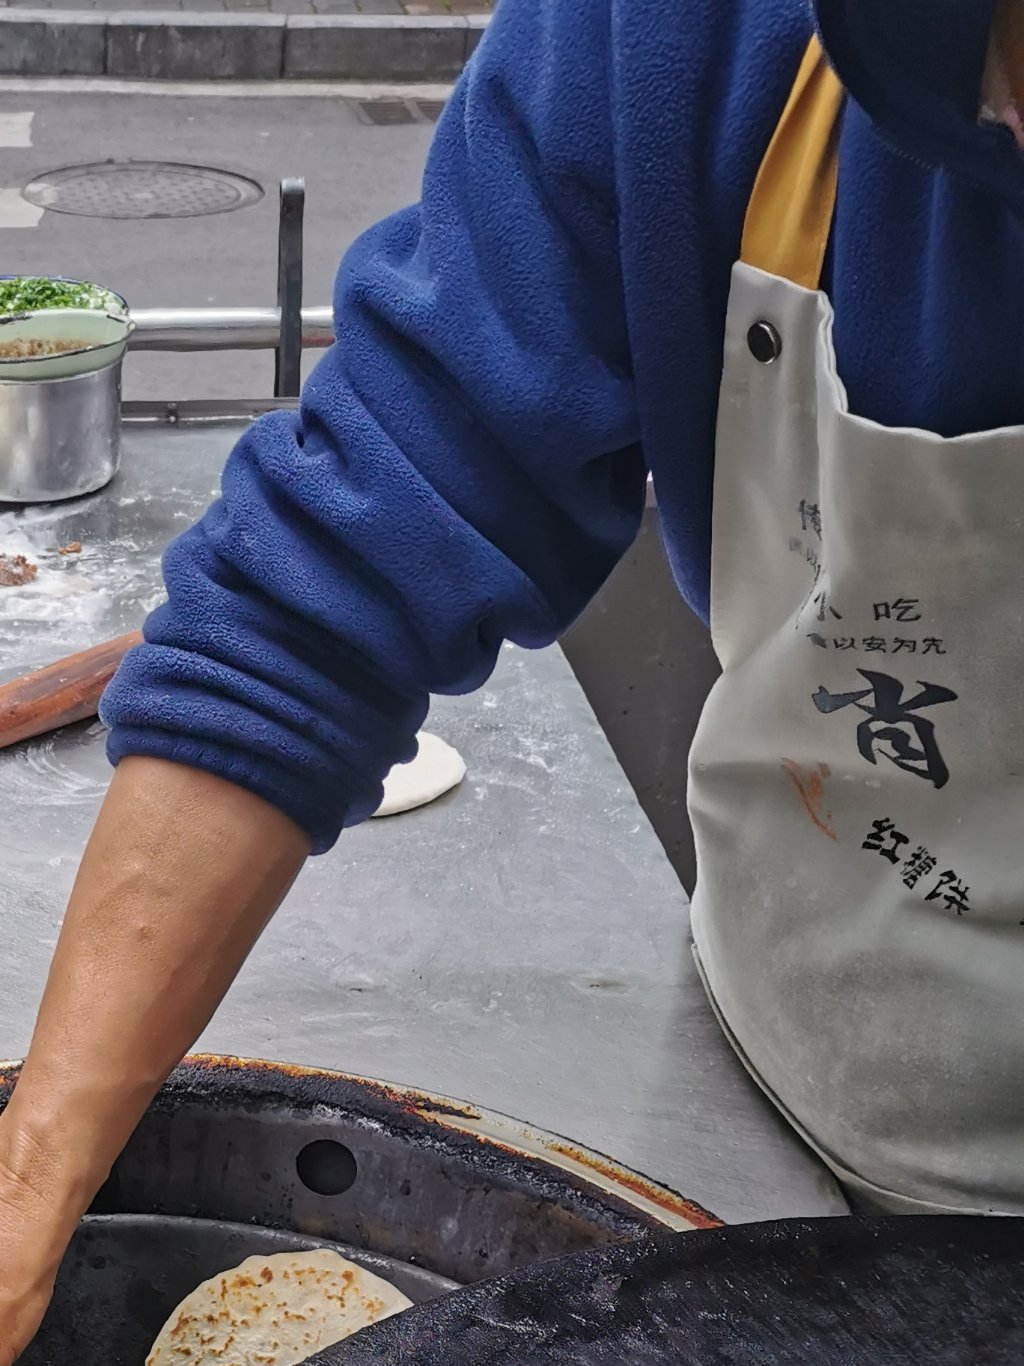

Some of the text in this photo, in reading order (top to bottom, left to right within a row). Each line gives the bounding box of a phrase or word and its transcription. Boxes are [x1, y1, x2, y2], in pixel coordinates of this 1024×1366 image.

[807, 632, 947, 655] 以安为先
[861, 817, 971, 916] 红糖饼
